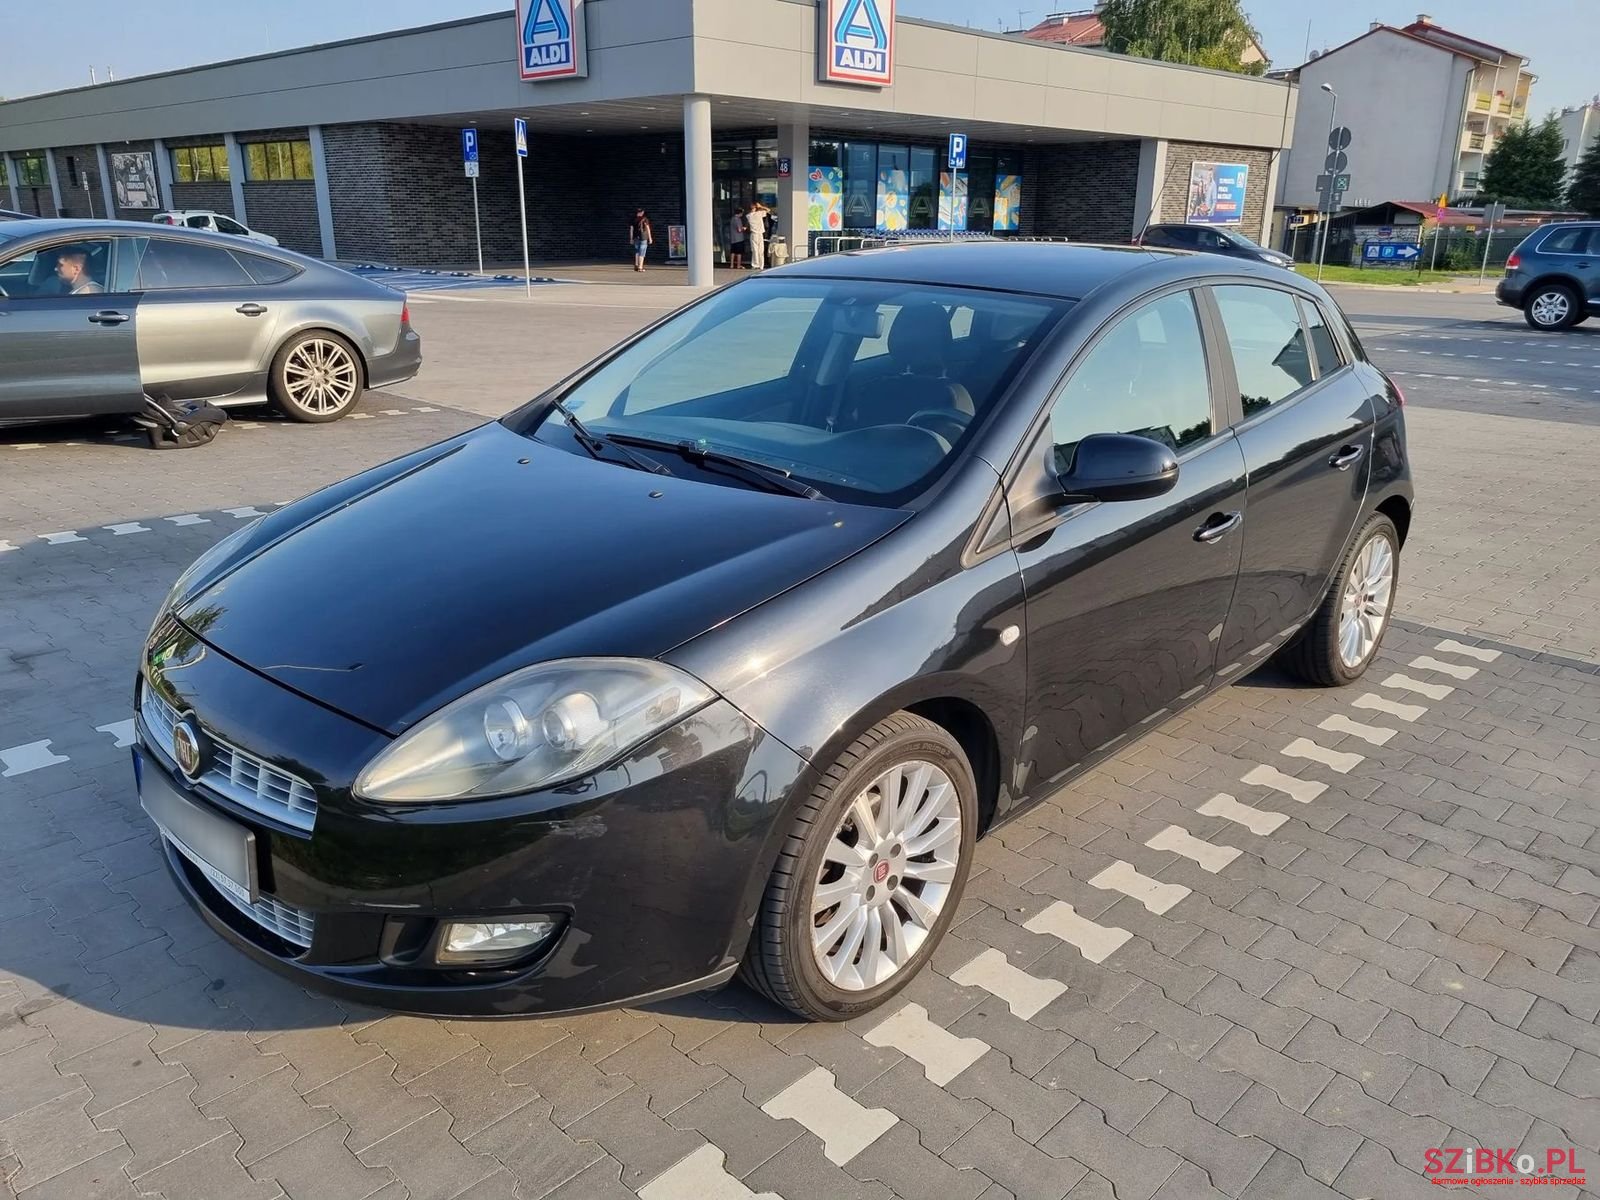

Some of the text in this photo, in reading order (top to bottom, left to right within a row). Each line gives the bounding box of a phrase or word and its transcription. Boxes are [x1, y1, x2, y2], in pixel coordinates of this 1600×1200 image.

[529, 43, 567, 66] ALDI
[839, 48, 882, 71] ALDI
[465, 131, 474, 153] P
[953, 136, 963, 158] P
[780, 162, 789, 173] 48
